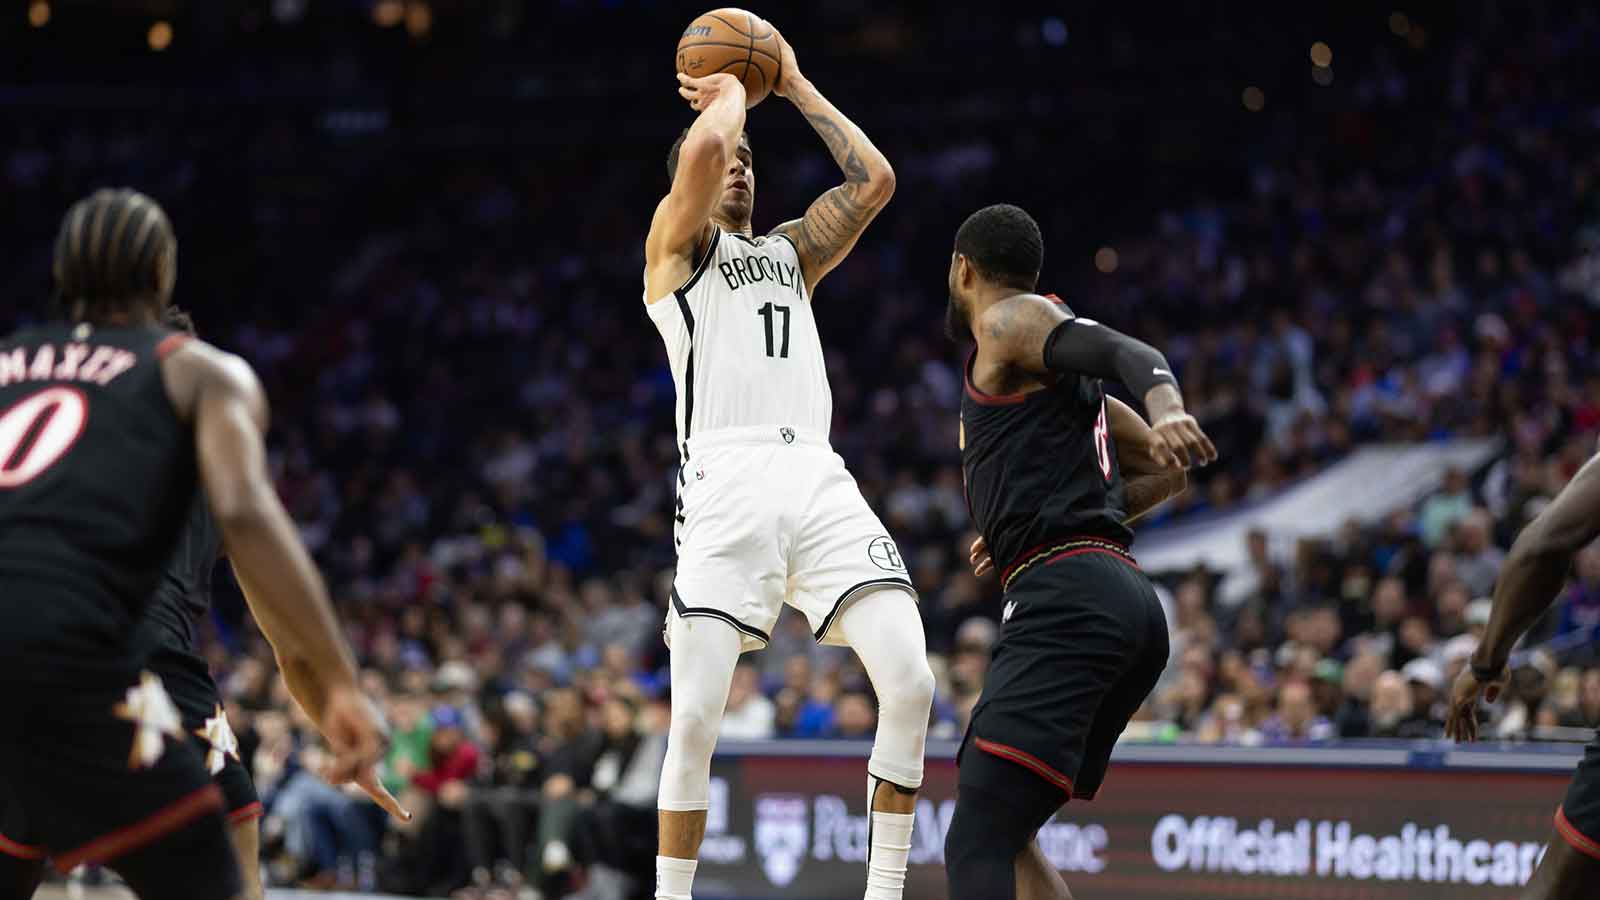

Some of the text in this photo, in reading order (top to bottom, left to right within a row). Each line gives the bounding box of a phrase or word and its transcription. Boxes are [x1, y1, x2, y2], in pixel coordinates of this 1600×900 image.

[757, 302, 791, 358] 17
[0, 384, 89, 491] 0
[1151, 814, 1311, 875] Official
[1315, 820, 1548, 887] Healthcar
